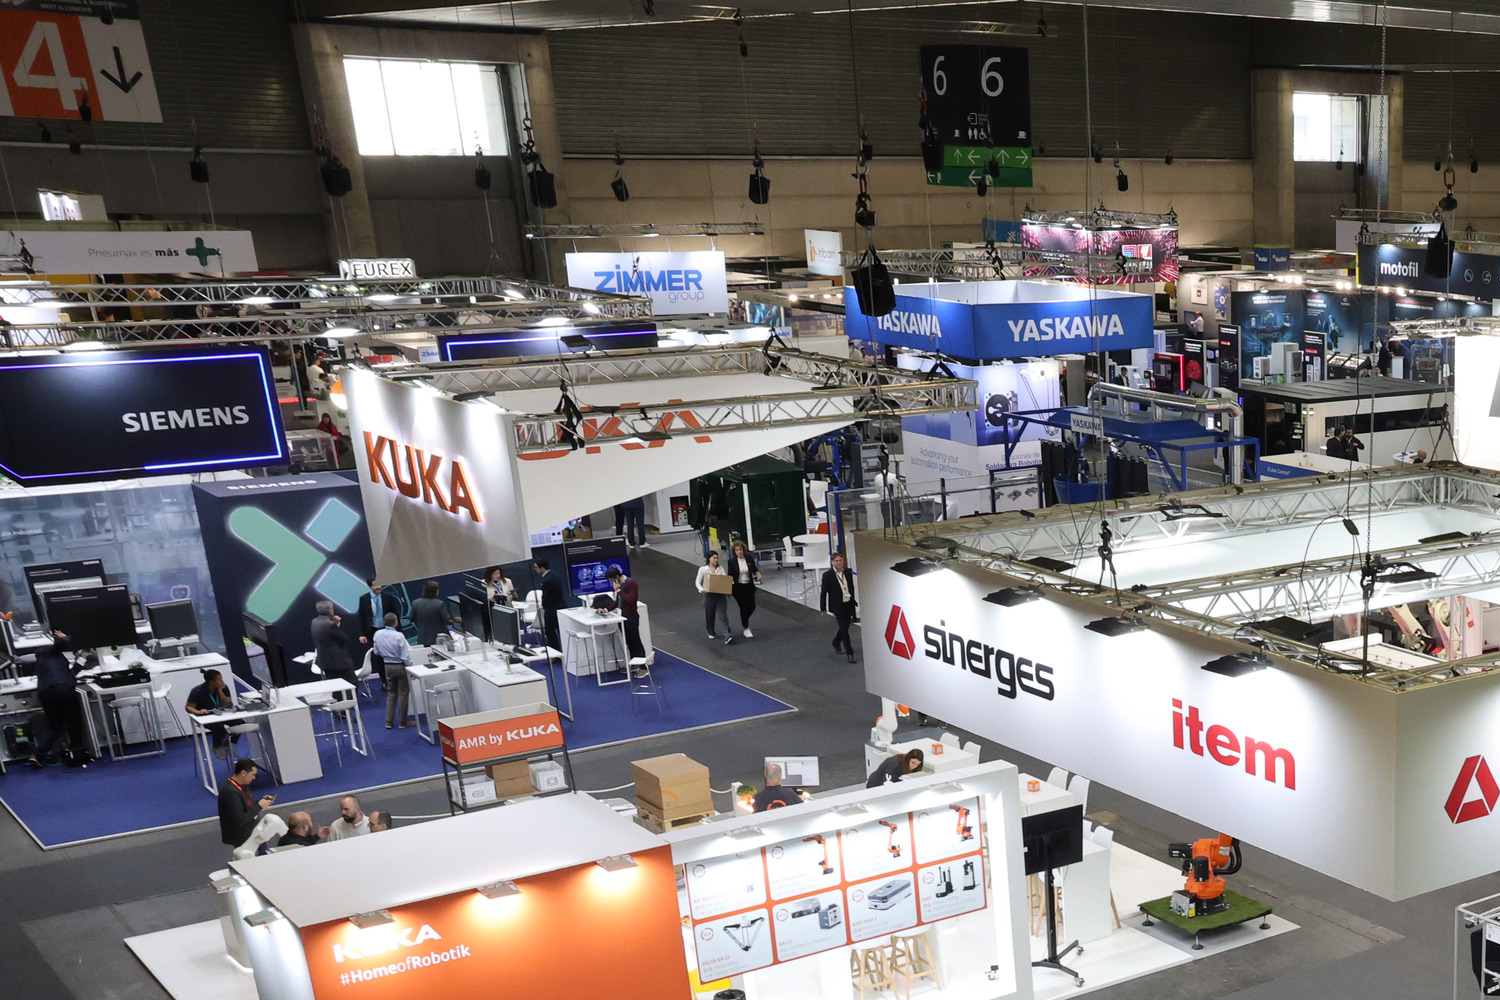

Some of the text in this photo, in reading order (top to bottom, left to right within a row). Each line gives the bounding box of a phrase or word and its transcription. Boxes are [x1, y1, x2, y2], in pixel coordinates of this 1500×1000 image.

[13, 21, 88, 110] 4
[933, 55, 947, 96] 6
[980, 56, 1004, 97] 6
[155, 247, 180, 257] más
[353, 260, 412, 277] EUREX
[1380, 261, 1420, 279] motofil
[669, 290, 705, 304] group
[876, 310, 942, 338] YASKAWA
[1007, 314, 1125, 343] YASKAWA
[121, 405, 251, 434] SIEMENS
[1071, 418, 1102, 432] YASKAWA
[362, 429, 484, 525] KUKA
[985, 460, 1018, 470] Soldara
[923, 619, 1056, 701] sinerges
[458, 722, 560, 751] AMR by KUKA
[1170, 697, 1297, 791] item
[333, 923, 443, 964] KUKA
[339, 943, 471, 986] #HomeofRobotik
